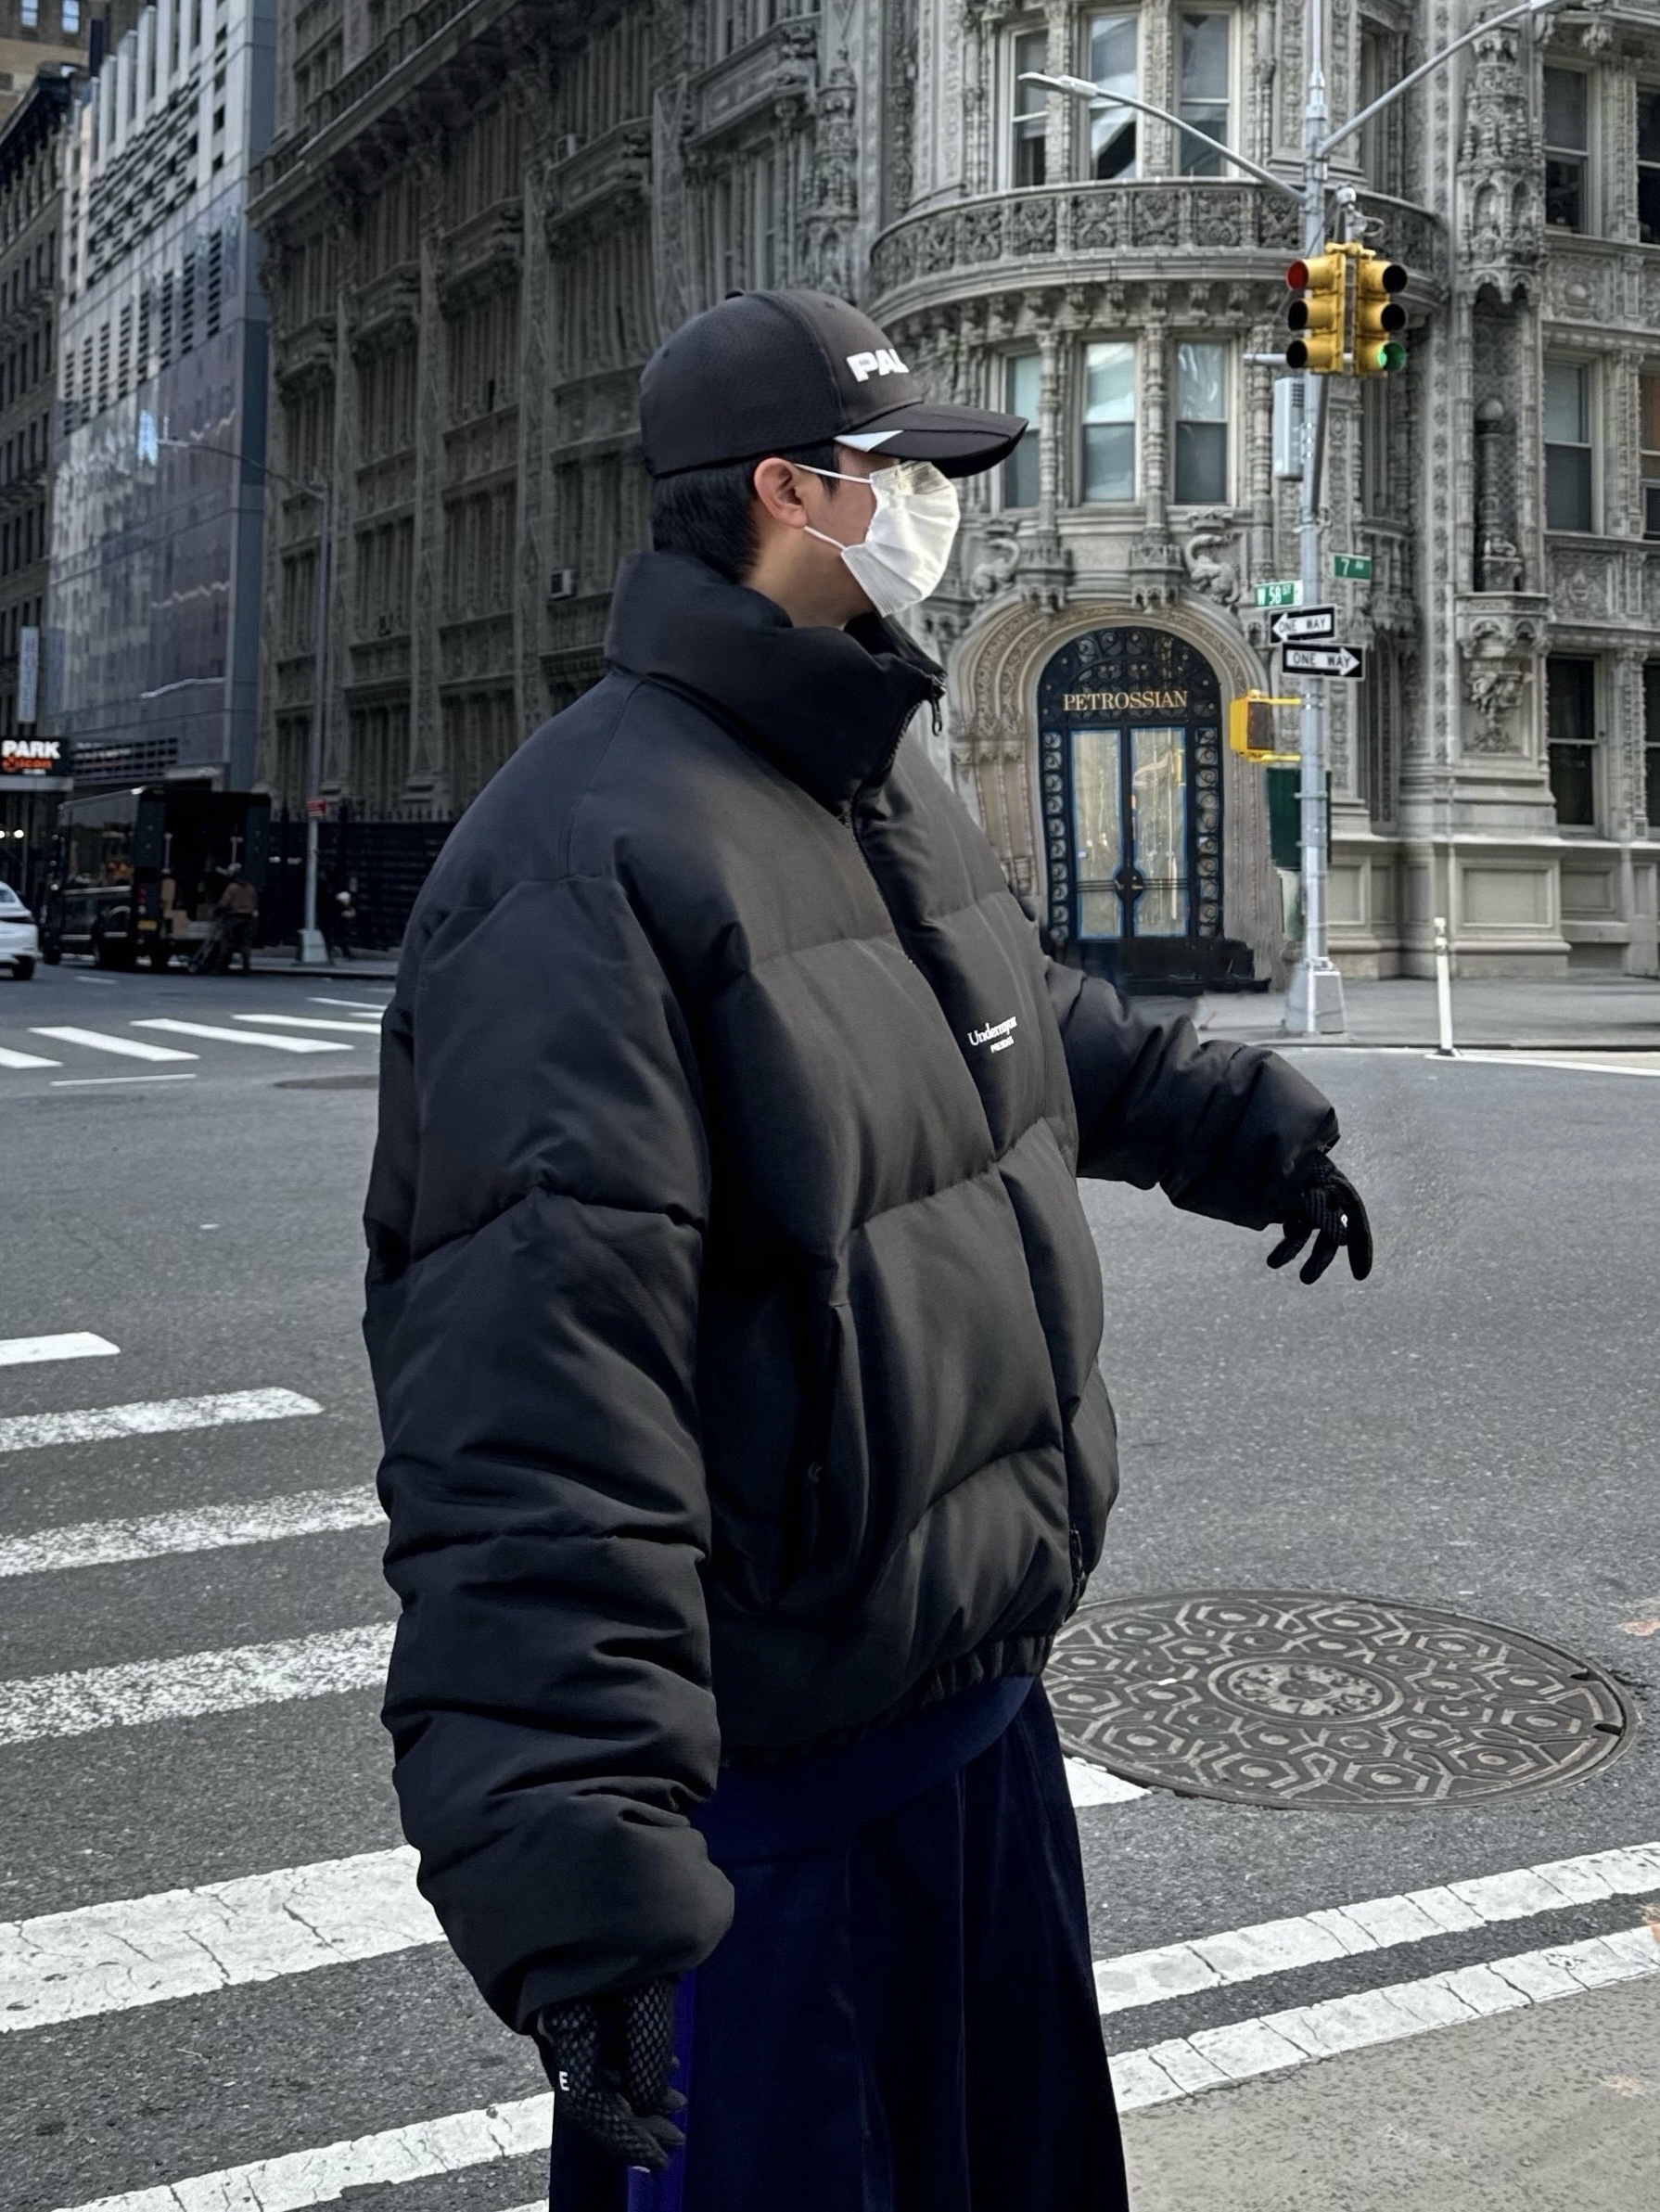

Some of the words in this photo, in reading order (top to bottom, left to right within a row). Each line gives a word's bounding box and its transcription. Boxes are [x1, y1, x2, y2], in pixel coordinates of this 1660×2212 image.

[1341, 558, 1350, 576] 7
[1279, 620, 1296, 633] ONE
[1306, 618, 1326, 630] WAY
[1294, 652, 1316, 666] ONE
[1327, 656, 1351, 667] WAY
[1063, 690, 1189, 711] PETROSSIAN
[2, 740, 61, 760] PARK
